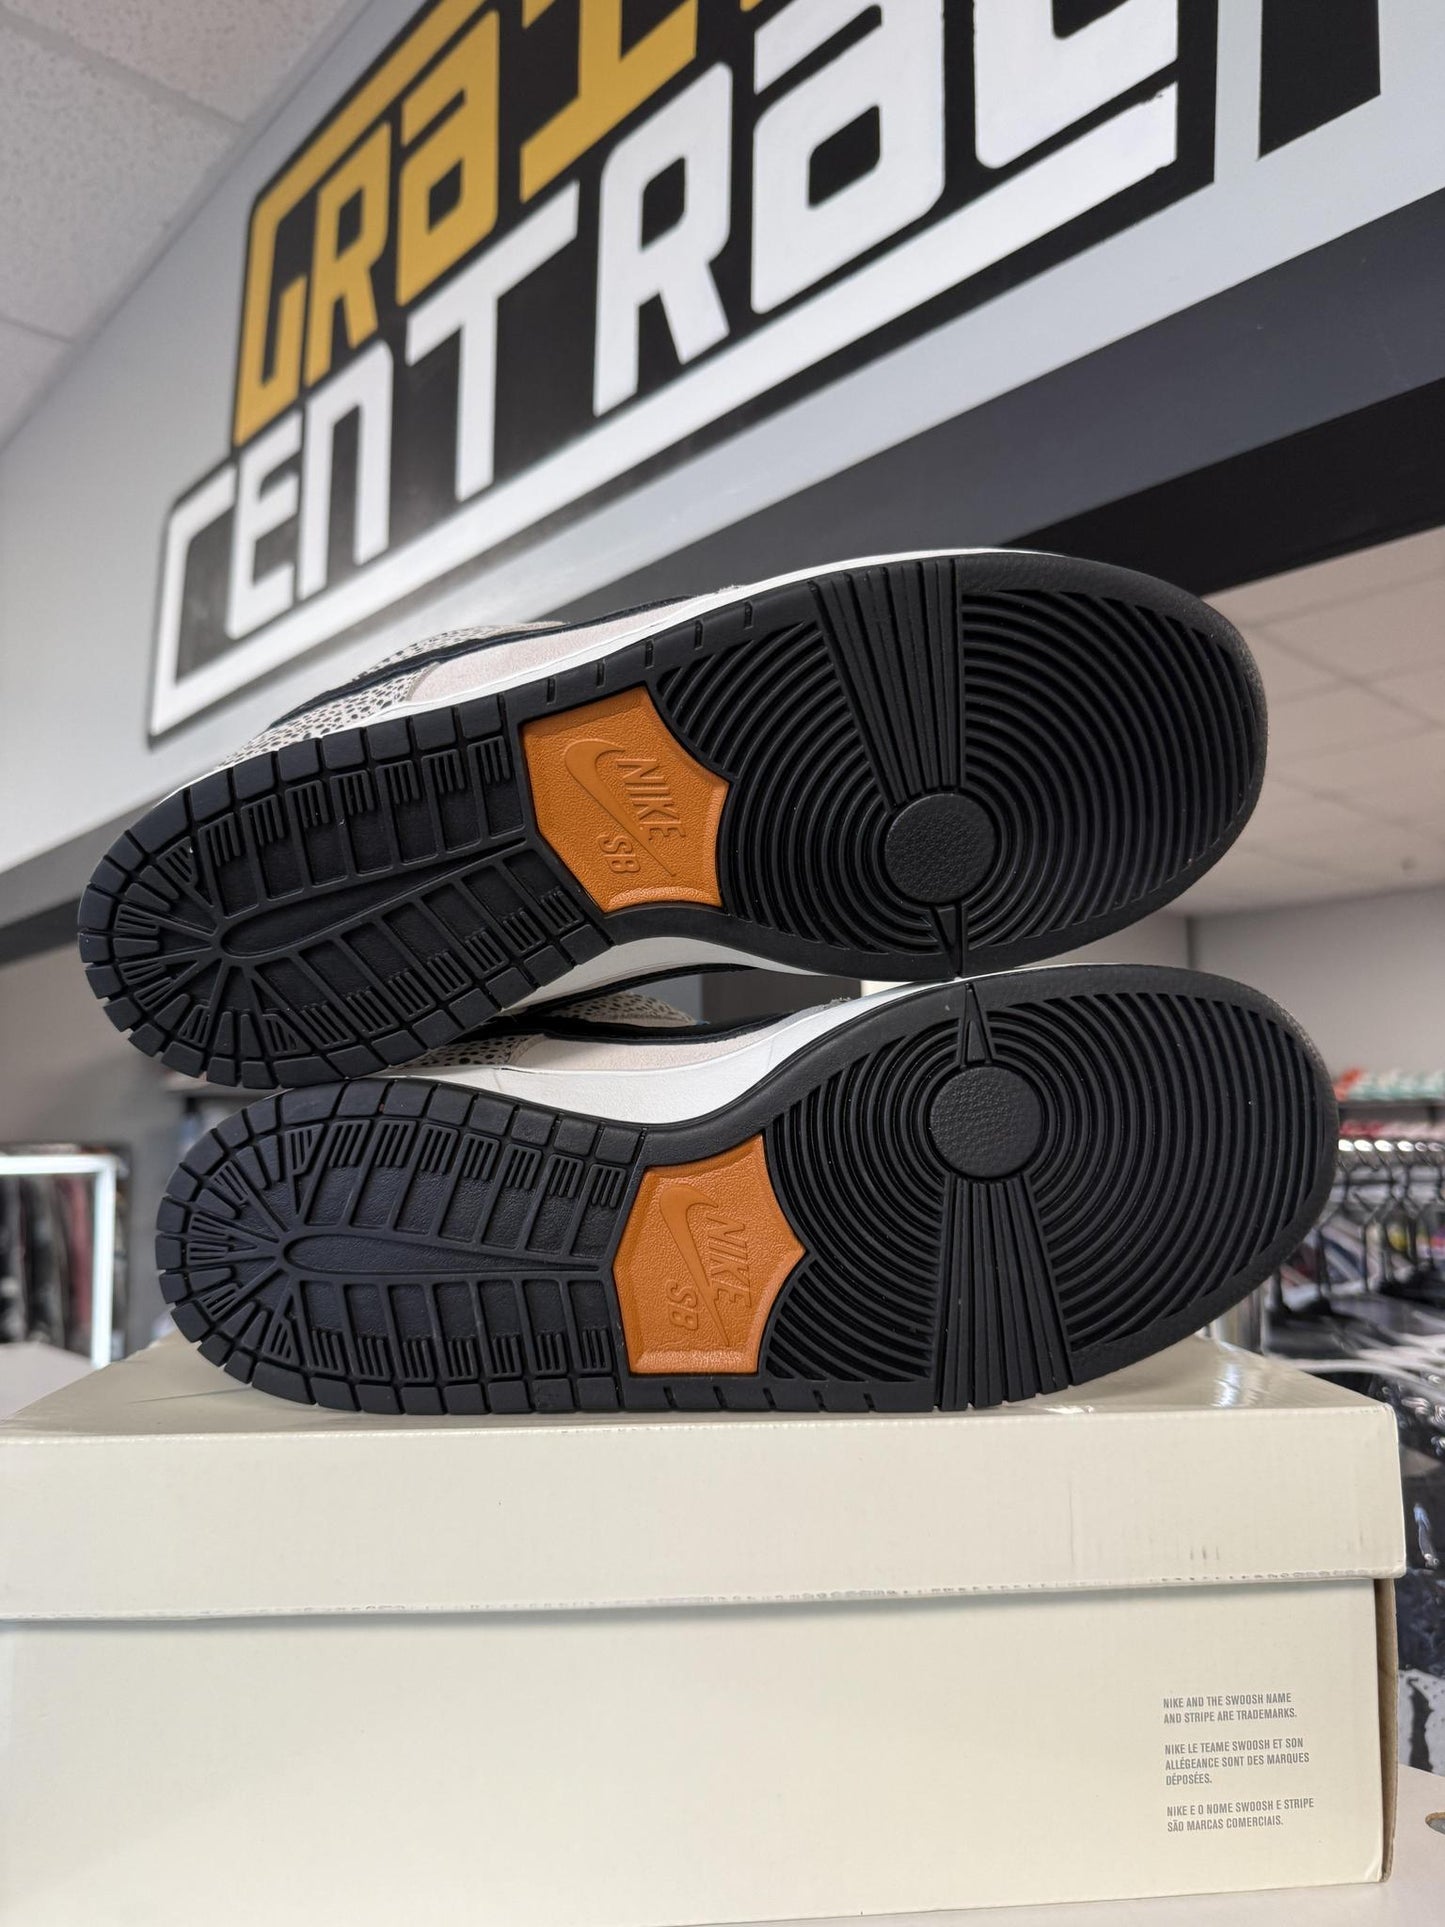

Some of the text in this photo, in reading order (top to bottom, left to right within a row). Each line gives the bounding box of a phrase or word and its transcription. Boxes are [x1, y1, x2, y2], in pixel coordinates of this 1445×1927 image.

[614, 757, 687, 841] NIKE
[597, 835, 642, 874] SB
[705, 1212, 753, 1309] NIKE
[665, 1279, 699, 1332] SB
[1163, 1693, 1292, 1709] NIKE AND THE SWOOSH NAME
[1164, 1707, 1297, 1724] AND STRIPE ARE TRADEMARKS.
[1165, 1737, 1303, 1755] NIKE LE TEAME SWOOSH ET SON
[1165, 1752, 1310, 1771] ALLÉGEANCE SONT DES MARQUES
[1166, 1771, 1212, 1786] DÉPOSÉES.
[1167, 1798, 1314, 1817] NIKE E O NOME SWOOSH E STRIPE
[1168, 1815, 1283, 1832] SÃO MARCAS COMERCIAIS.
